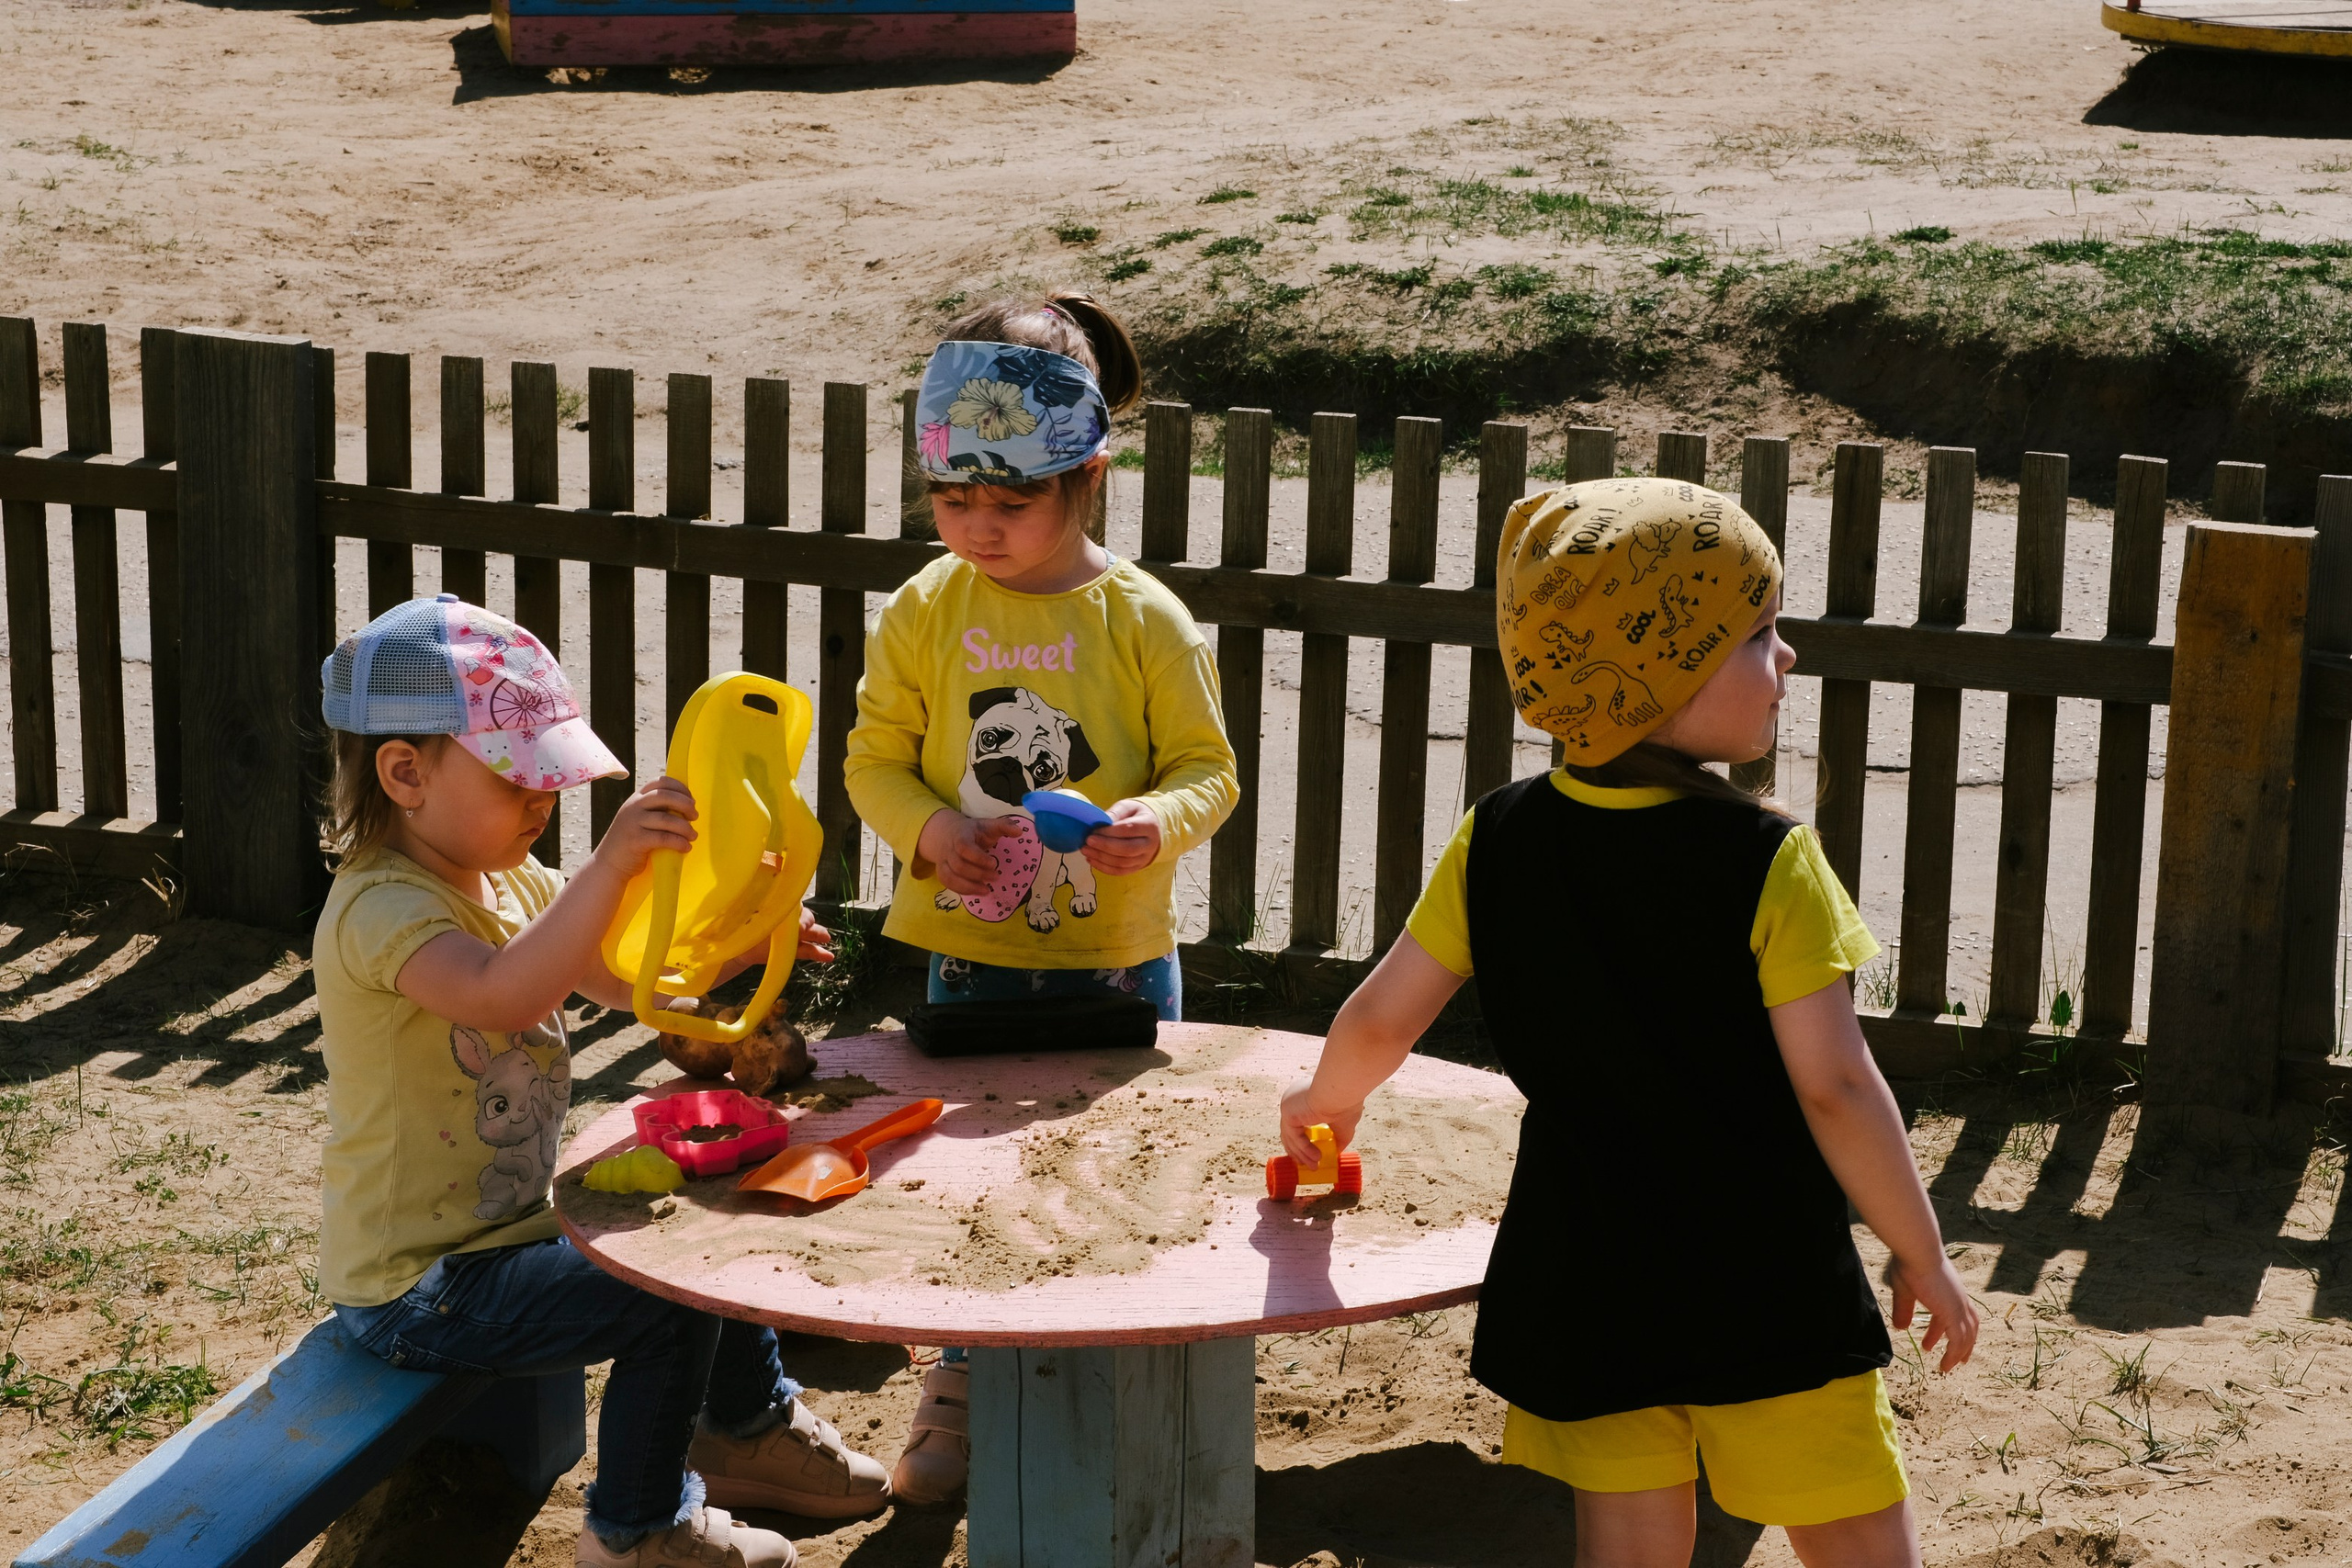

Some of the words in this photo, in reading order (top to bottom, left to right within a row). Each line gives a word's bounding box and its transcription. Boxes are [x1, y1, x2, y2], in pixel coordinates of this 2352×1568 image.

[1566, 508, 1623, 555] ROAR!
[1748, 574, 1771, 607] COOL
[963, 627, 1078, 673] Sweet
[1625, 609, 1657, 645] COOL
[1677, 623, 1731, 672] ROAR!
